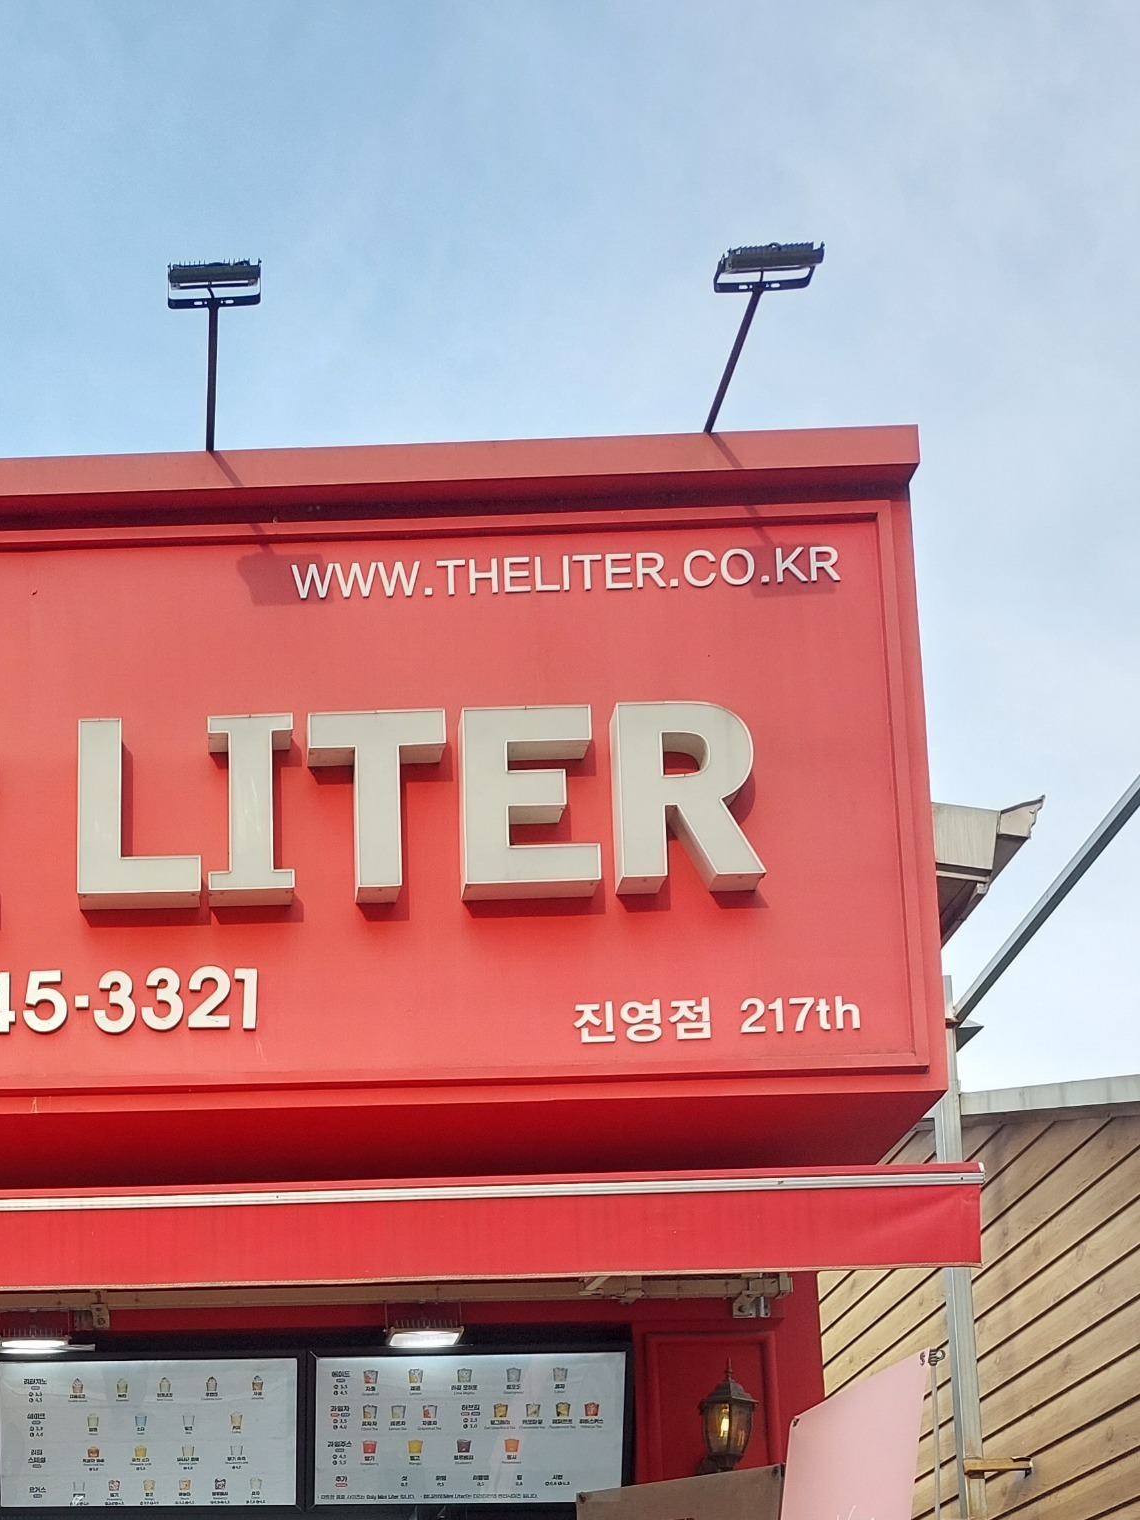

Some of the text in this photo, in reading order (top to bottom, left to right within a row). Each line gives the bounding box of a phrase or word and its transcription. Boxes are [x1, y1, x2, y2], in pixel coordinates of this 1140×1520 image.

[291, 545, 842, 599] WWW.THELITER.CO.KR
[77, 701, 766, 911] LITER
[572, 995, 862, 1044] 진영점 217th
